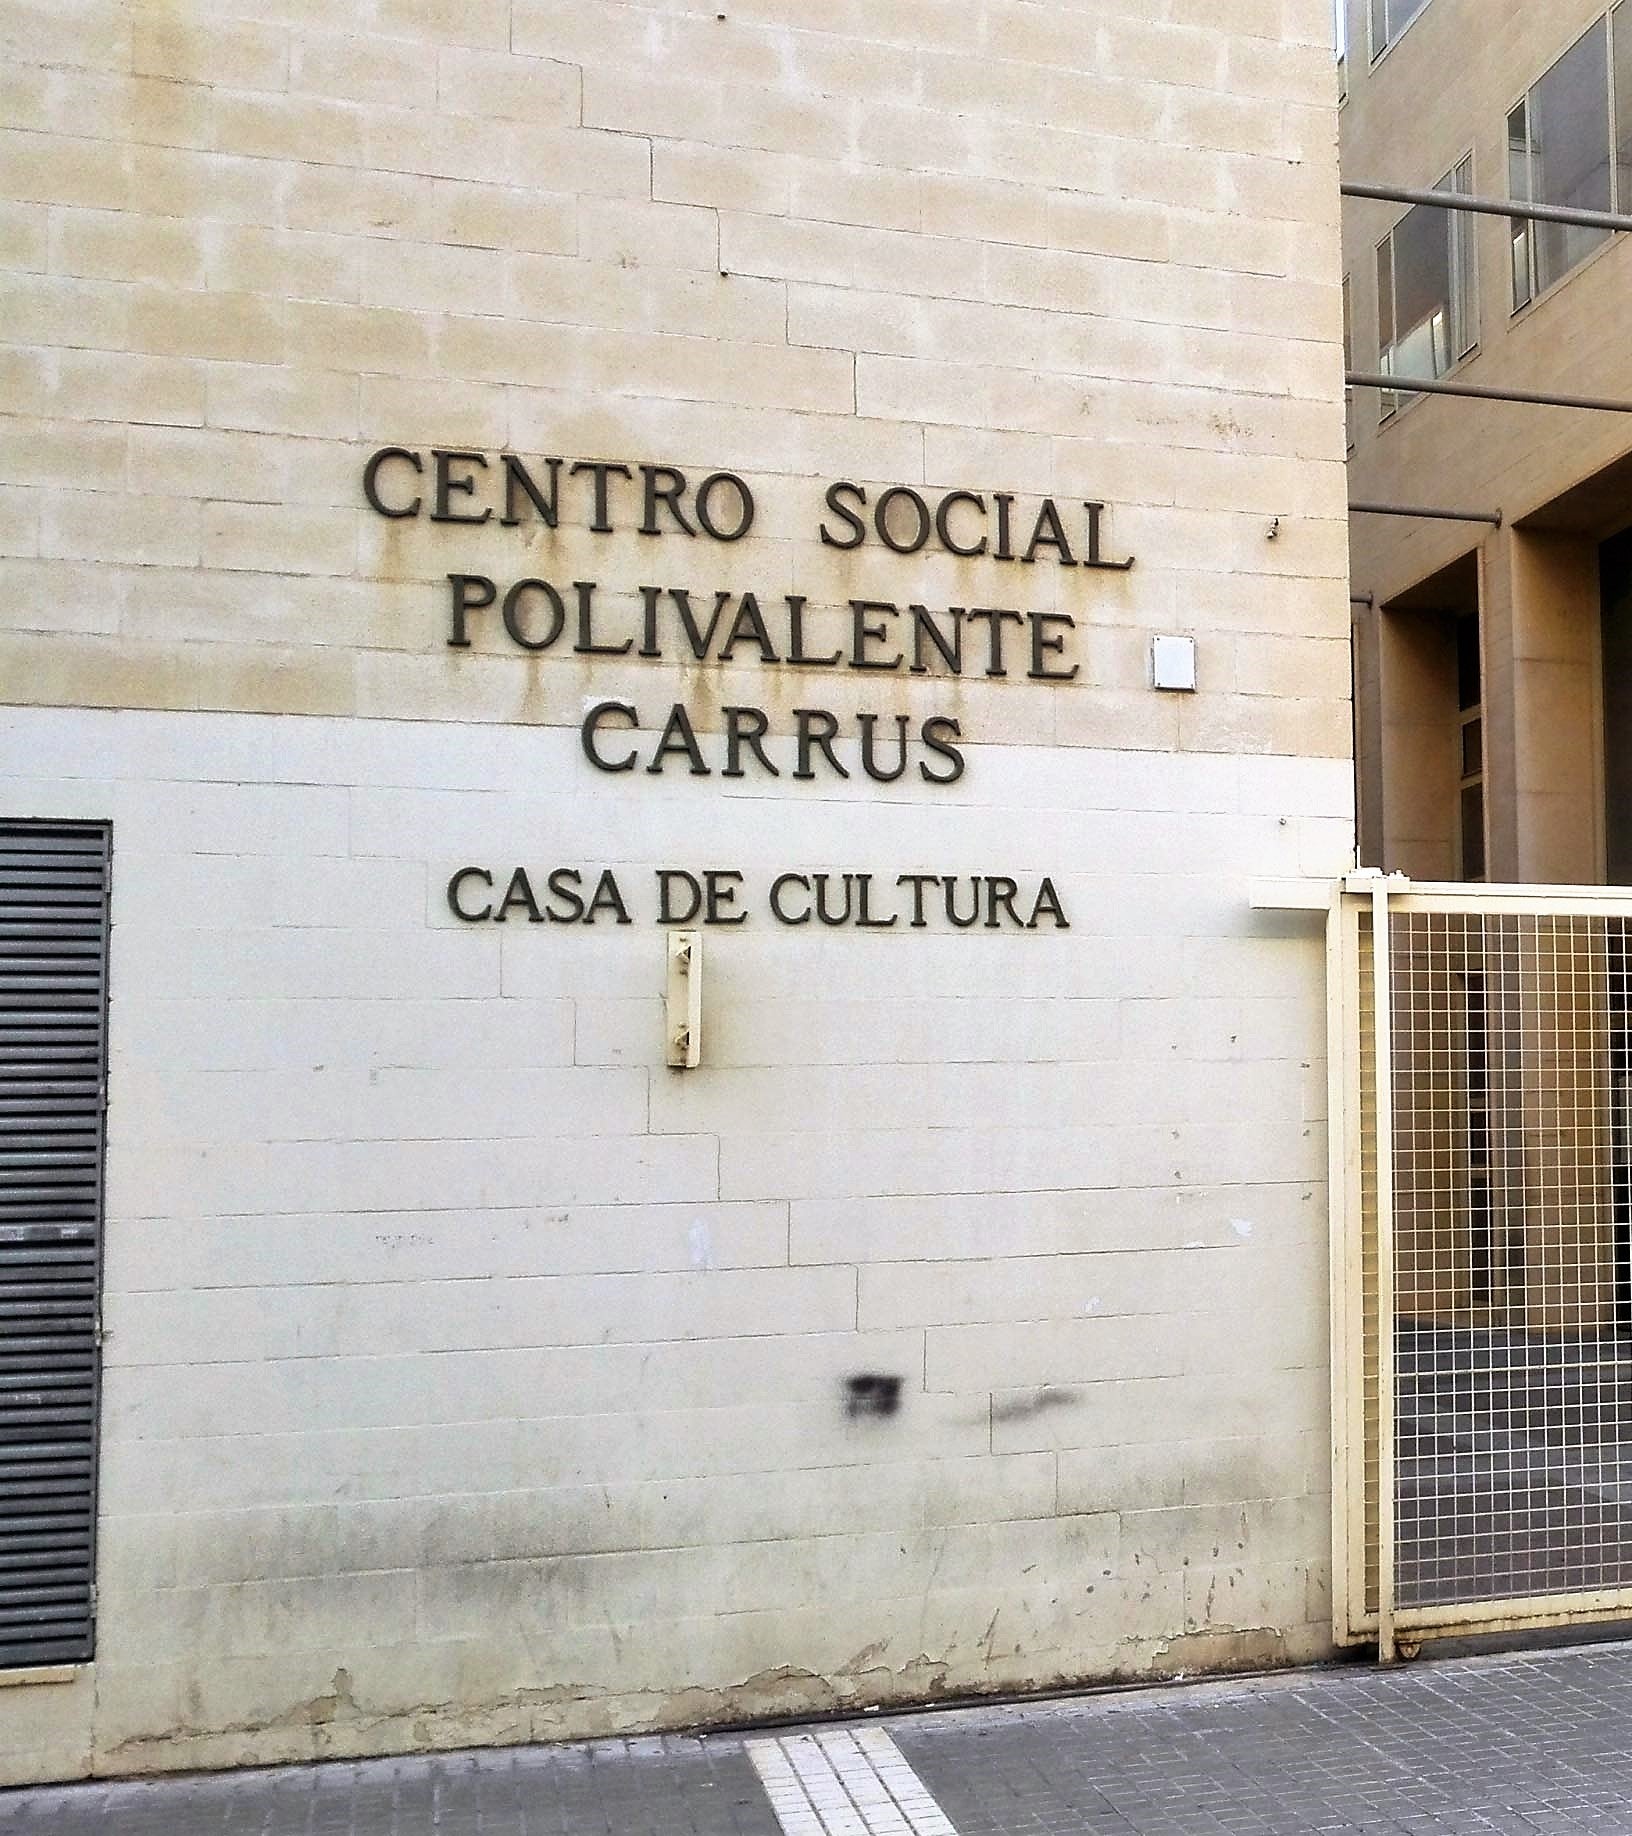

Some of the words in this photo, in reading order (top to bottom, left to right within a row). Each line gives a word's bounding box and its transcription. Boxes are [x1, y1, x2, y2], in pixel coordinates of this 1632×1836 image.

[364, 448, 754, 541] CENTRO
[820, 482, 1135, 570] SOCIAL
[447, 574, 1079, 679] POLIVALENTE
[582, 701, 965, 784] CARRUS
[448, 867, 632, 924] CASA
[656, 870, 748, 925] DE
[770, 873, 1070, 929] CULTURA
